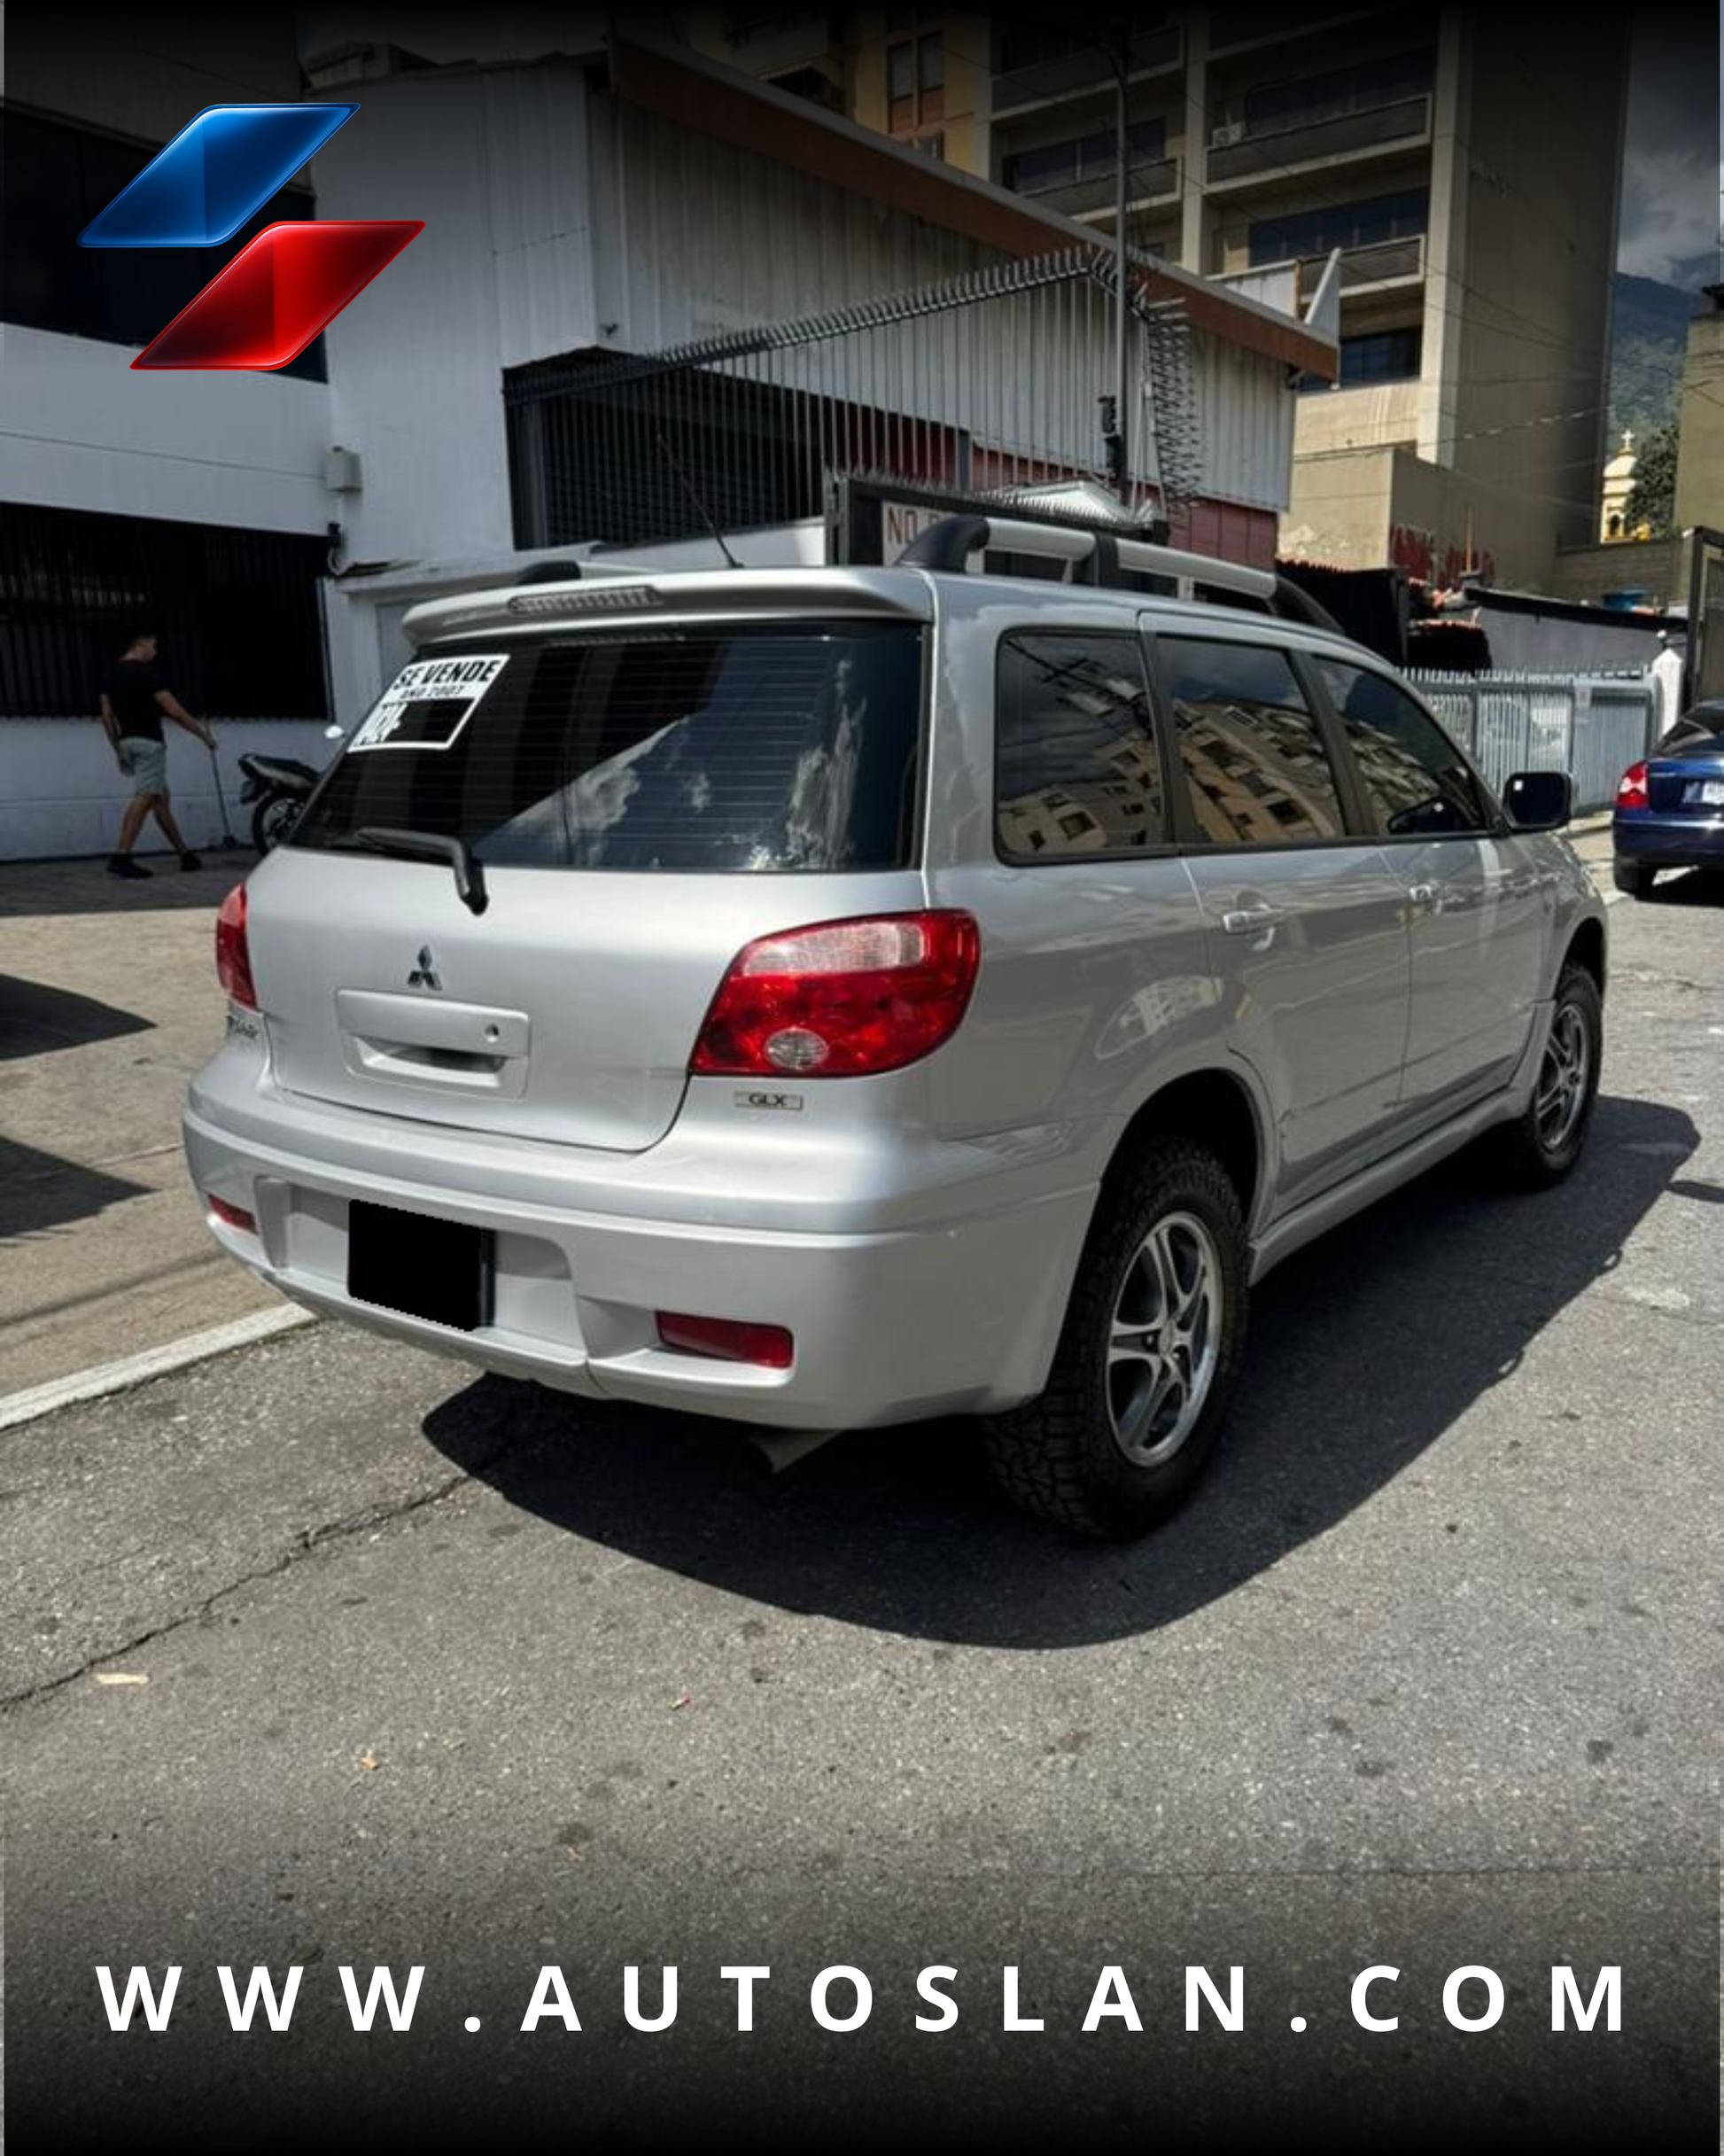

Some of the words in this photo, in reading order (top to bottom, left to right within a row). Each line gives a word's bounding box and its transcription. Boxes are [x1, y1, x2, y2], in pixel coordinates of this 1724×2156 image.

[887, 506, 918, 544] NO
[421, 659, 502, 684] VENDE
[749, 1092, 786, 1108] GLX
